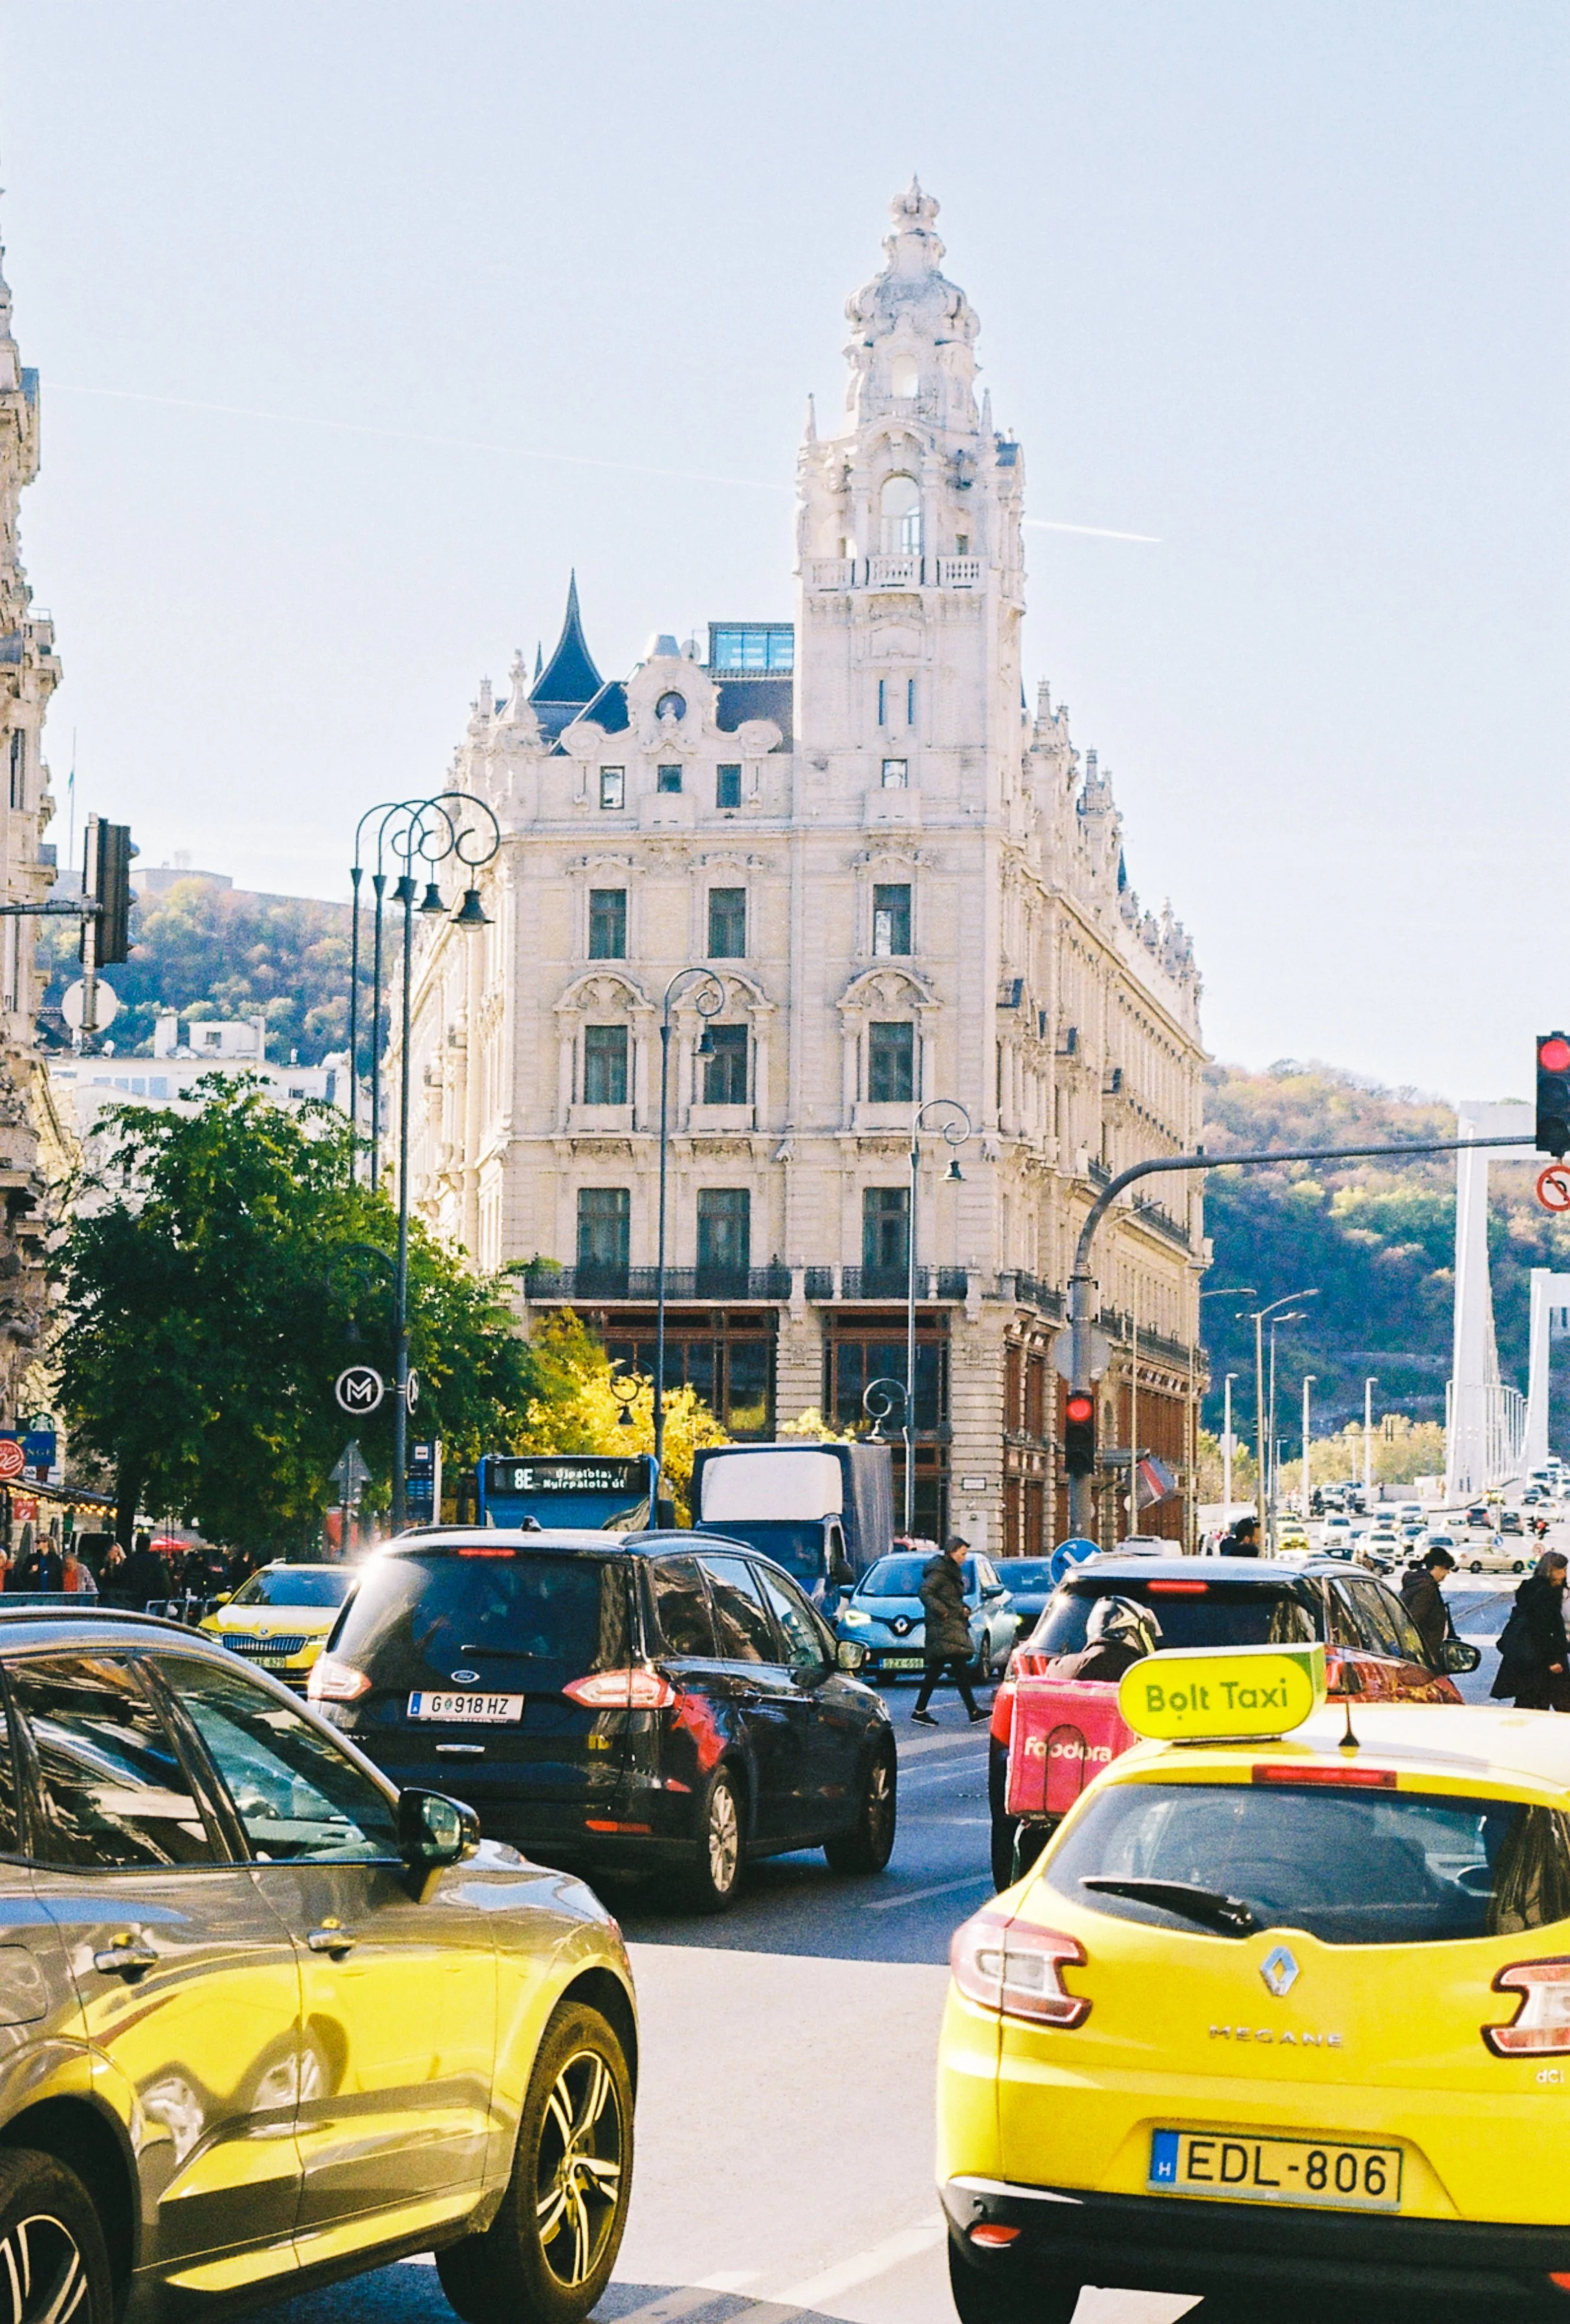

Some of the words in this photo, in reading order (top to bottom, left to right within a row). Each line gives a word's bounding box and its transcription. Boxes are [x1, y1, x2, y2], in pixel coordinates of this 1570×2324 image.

[514, 1468, 533, 1489] 8E
[543, 1478, 608, 1489] Nyírpalota
[612, 1477, 625, 1488] út
[432, 1696, 441, 1712] G
[455, 1697, 483, 1714] 918
[487, 1698, 509, 1714] HZ
[1146, 1683, 1210, 1716] Bolt
[1220, 1677, 1287, 1709] Taxi
[1024, 1736, 1112, 1762] foodora
[1209, 2024, 1343, 2048] MEGANE
[1158, 2162, 1171, 2176] H
[1188, 2140, 1386, 2196] EDL-806
